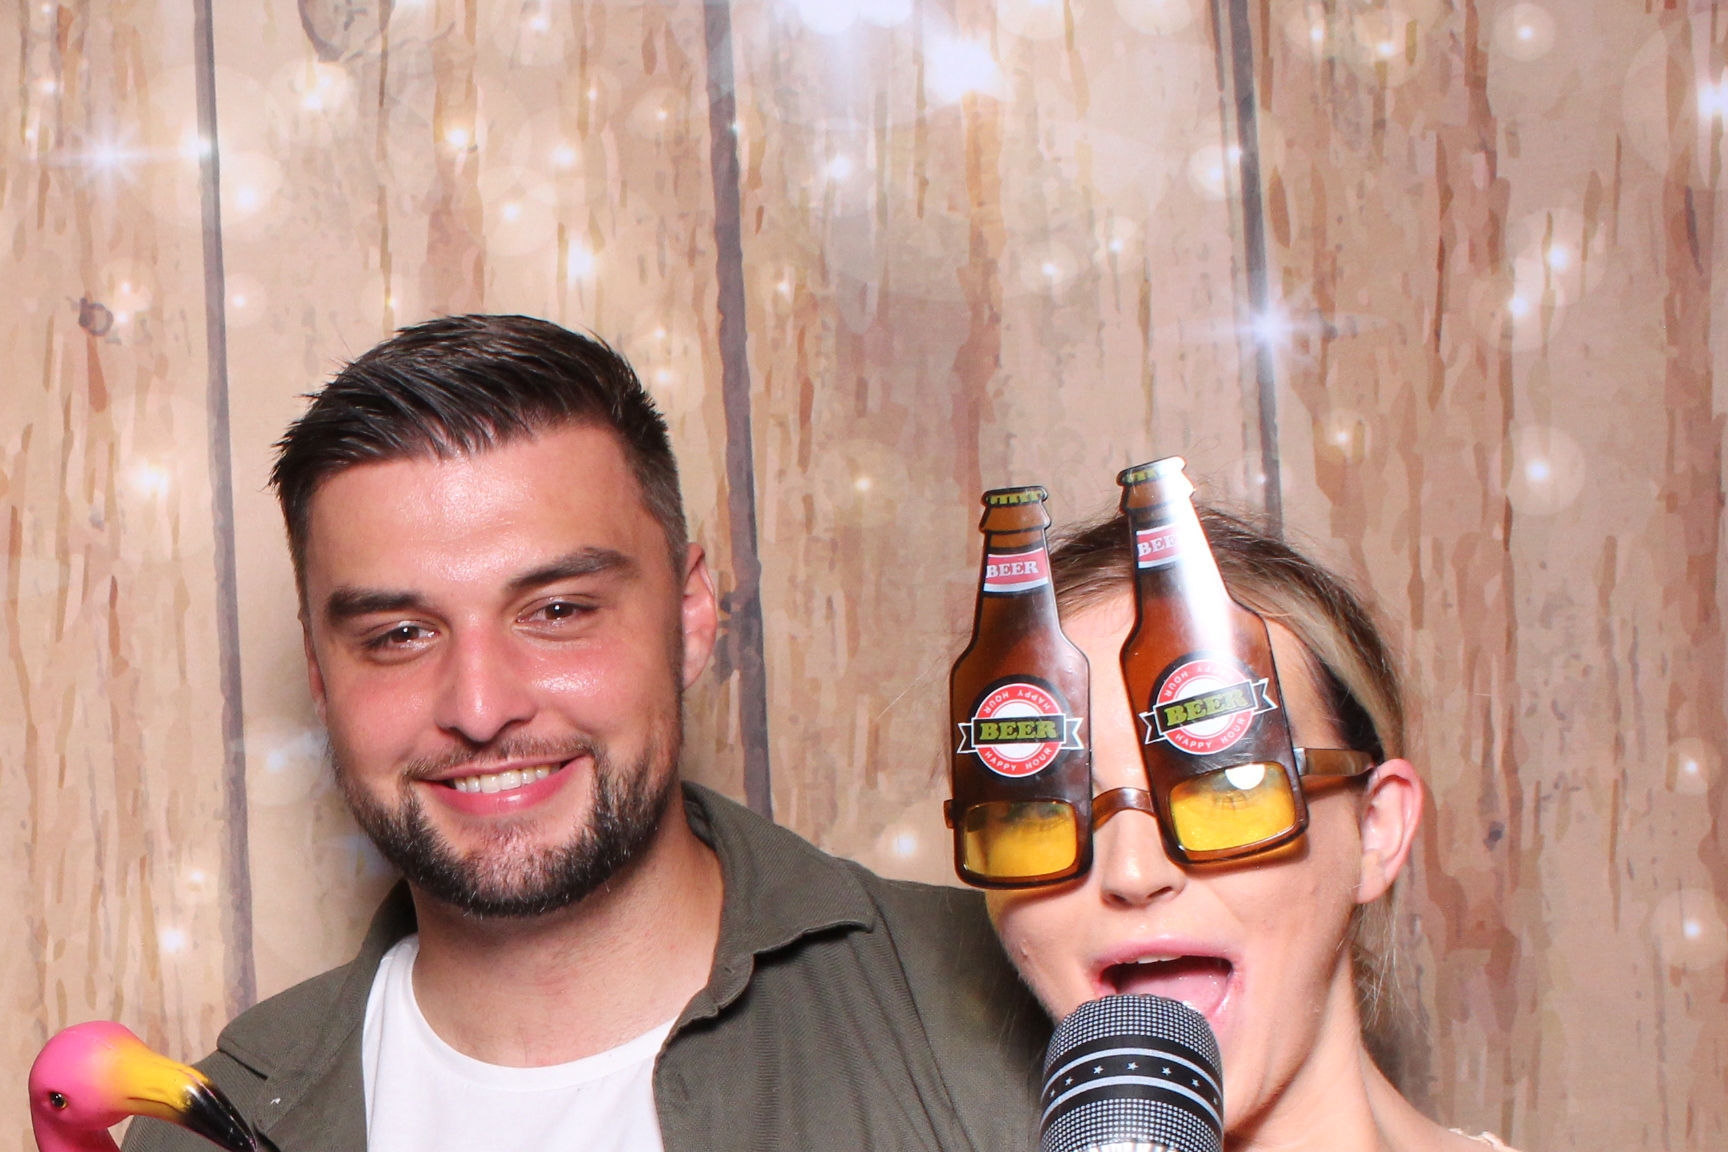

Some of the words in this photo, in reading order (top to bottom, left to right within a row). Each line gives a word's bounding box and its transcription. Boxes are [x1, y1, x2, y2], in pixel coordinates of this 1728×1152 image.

[1136, 533, 1181, 558] BEE
[985, 560, 1040, 579] BEER
[1163, 670, 1189, 698] HOUR
[983, 691, 1010, 715] HOUR
[1017, 689, 1051, 711] HAPPY
[1163, 689, 1249, 727] BEER
[979, 720, 1058, 741] BEER
[1175, 733, 1213, 749] HAPPY
[1220, 716, 1247, 744] HOUR
[984, 750, 1017, 771] HAPPY
[1025, 747, 1053, 770] HOUR
